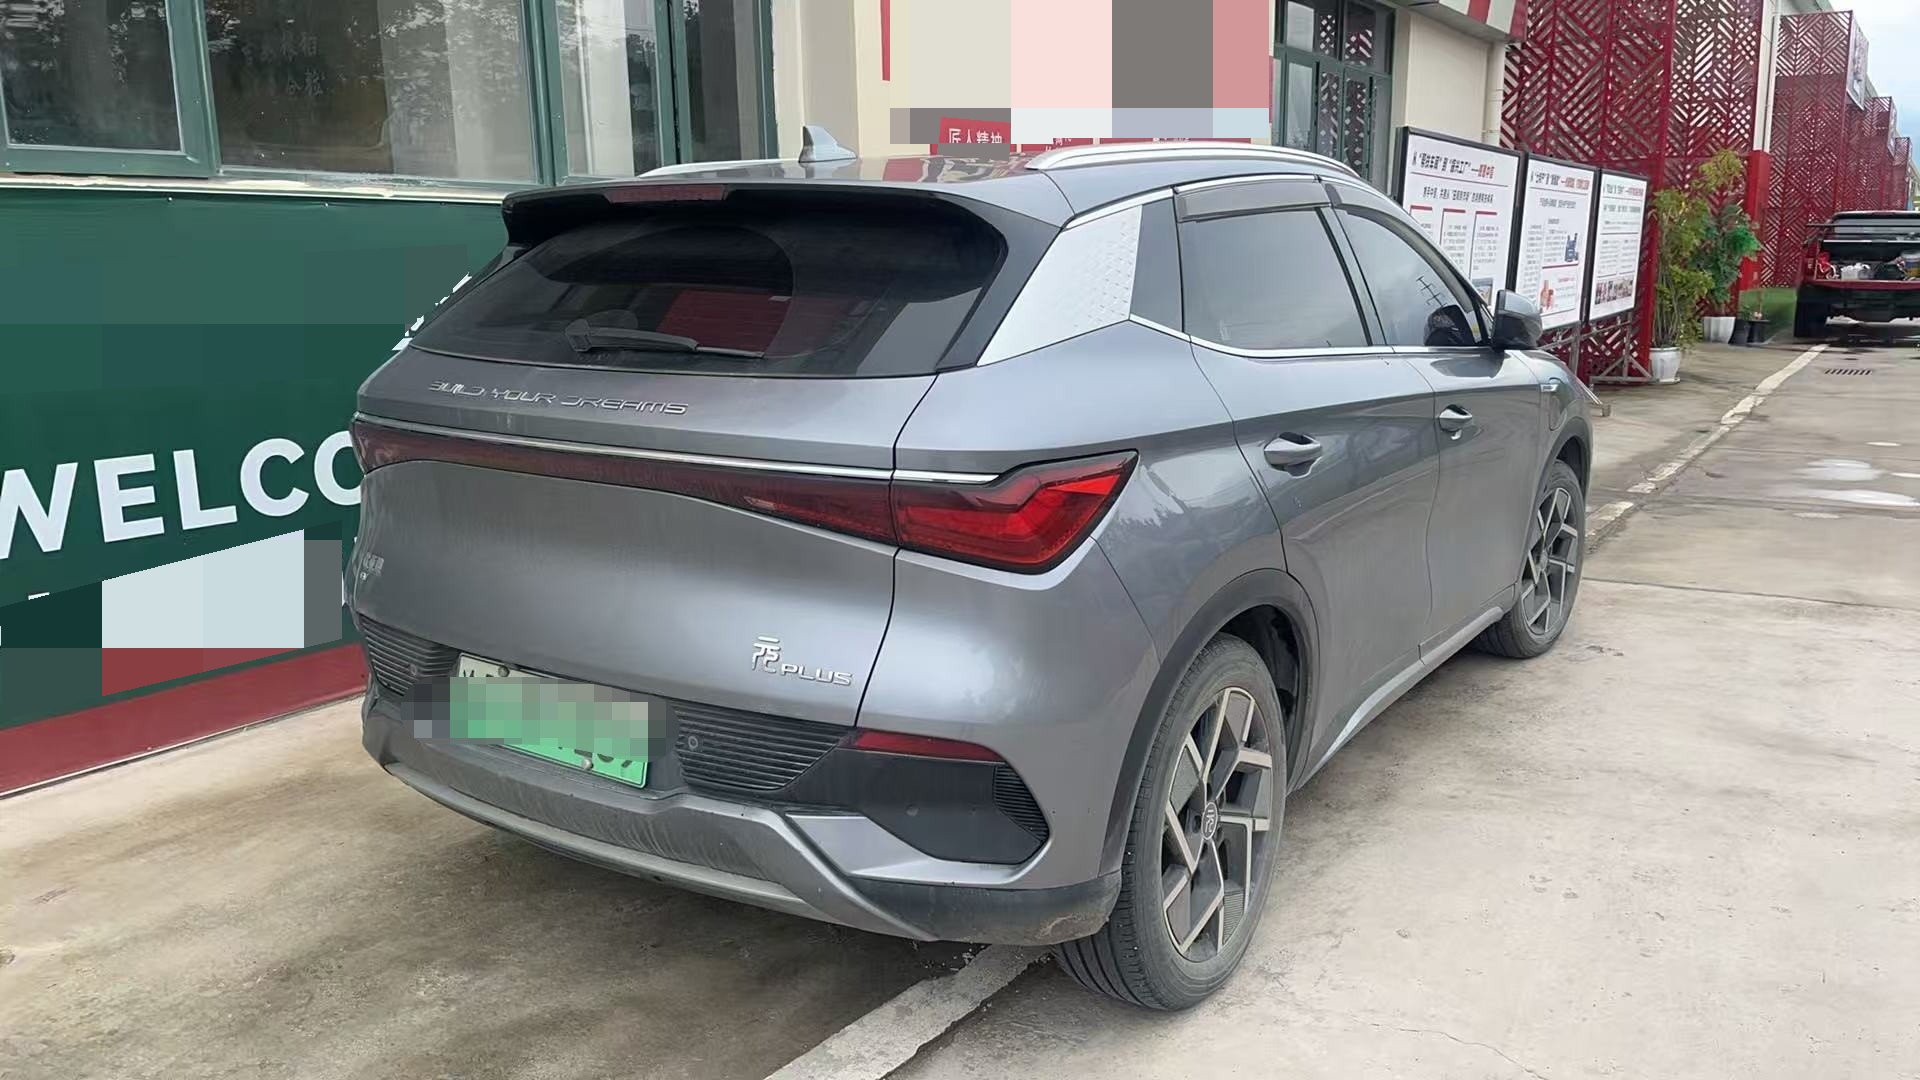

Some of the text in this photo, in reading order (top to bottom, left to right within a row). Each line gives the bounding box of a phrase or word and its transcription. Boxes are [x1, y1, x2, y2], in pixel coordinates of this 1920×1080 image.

[428, 380, 690, 416] BUILD YOUR DREAMS
[780, 663, 853, 687] PLUS
